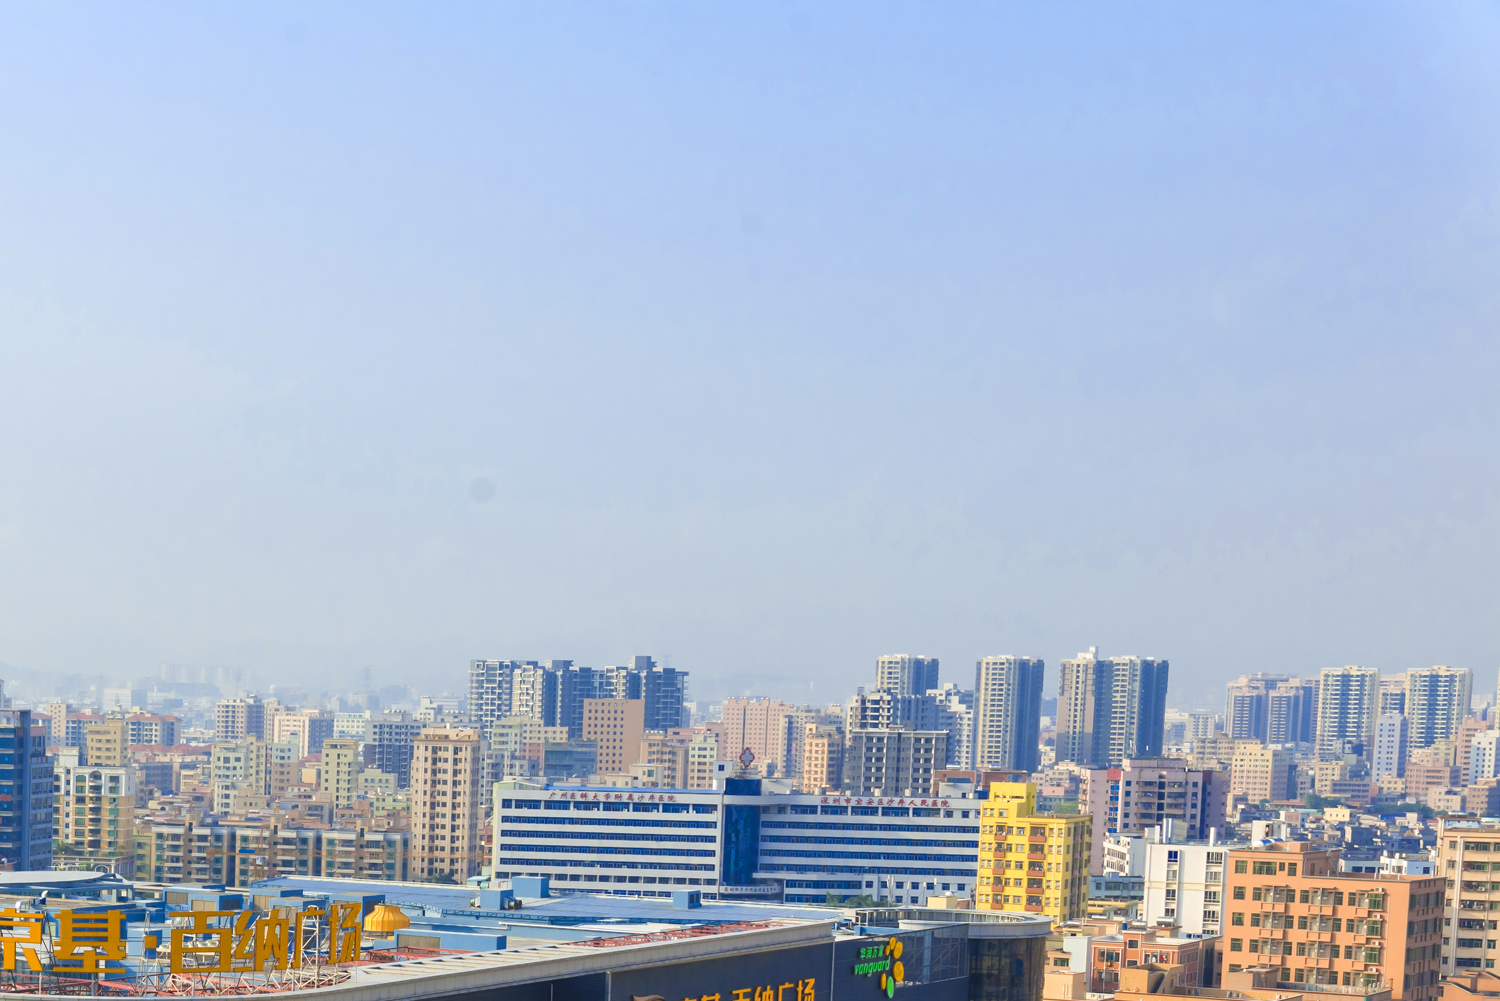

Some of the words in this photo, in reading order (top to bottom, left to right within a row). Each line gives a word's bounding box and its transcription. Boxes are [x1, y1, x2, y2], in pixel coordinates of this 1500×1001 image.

[548, 791, 676, 803] 广州医科大学附属沙井医院
[821, 797, 949, 808] 深圳市宝安区沙井人民医院
[860, 945, 884, 960] 华润万家
[854, 956, 891, 977] vanguard
